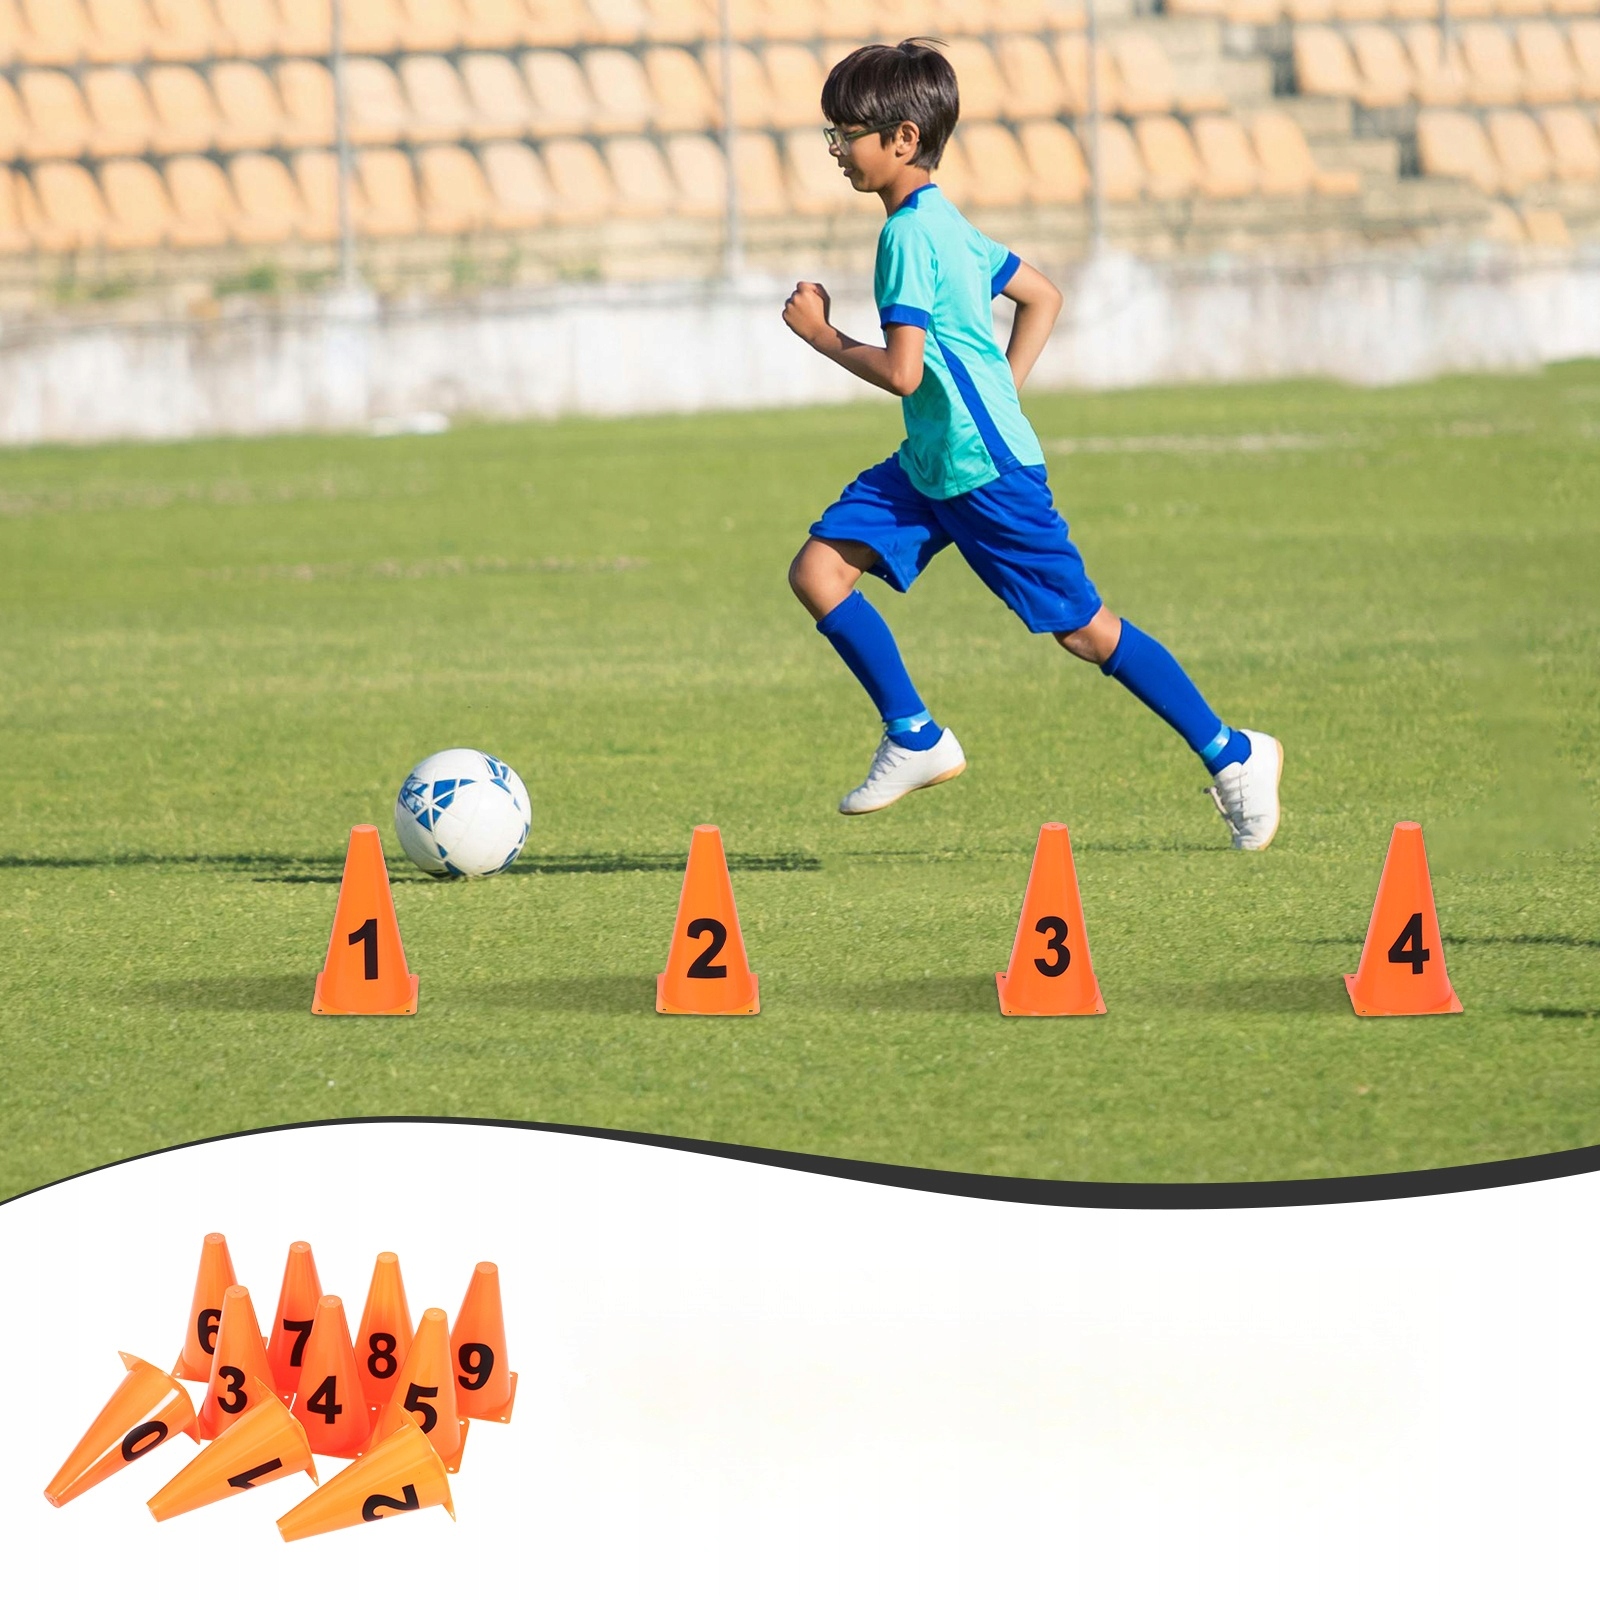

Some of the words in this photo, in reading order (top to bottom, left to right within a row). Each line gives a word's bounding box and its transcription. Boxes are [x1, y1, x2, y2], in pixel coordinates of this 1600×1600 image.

[348, 918, 378, 980] 1
[687, 918, 727, 979] 2
[1034, 916, 1071, 978] 3
[1388, 912, 1430, 975] 4
[197, 1308, 222, 1355] 6
[283, 1319, 314, 1367] 7
[367, 1332, 397, 1379] 8
[218, 1366, 247, 1414] 3
[458, 1343, 494, 1391] 9
[307, 1375, 342, 1424] 4
[403, 1383, 438, 1435] 5
[121, 1420, 168, 1461] 0
[227, 1457, 283, 1490] 1
[362, 1484, 419, 1522] 2
